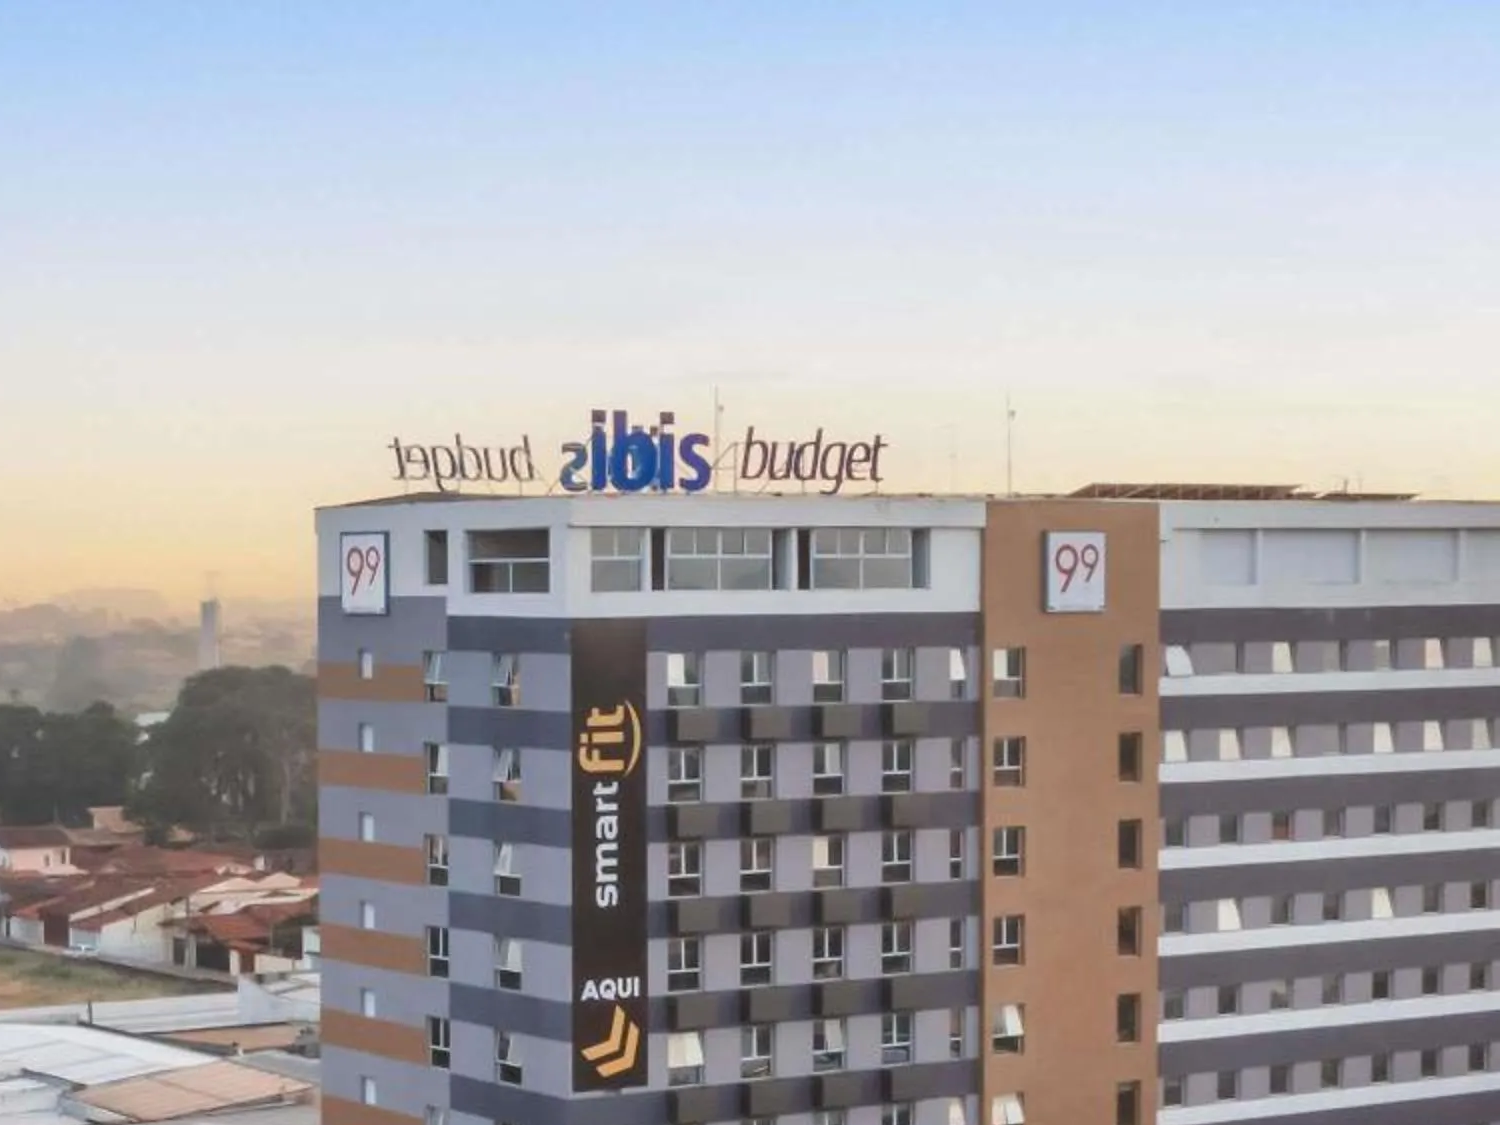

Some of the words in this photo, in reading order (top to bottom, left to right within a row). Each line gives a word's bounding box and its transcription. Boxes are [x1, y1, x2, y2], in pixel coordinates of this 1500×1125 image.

[592, 409, 711, 491] ibis
[740, 426, 888, 495] budget
[579, 705, 625, 774] fit
[593, 781, 619, 908] smart
[581, 976, 639, 1001] AQUI
